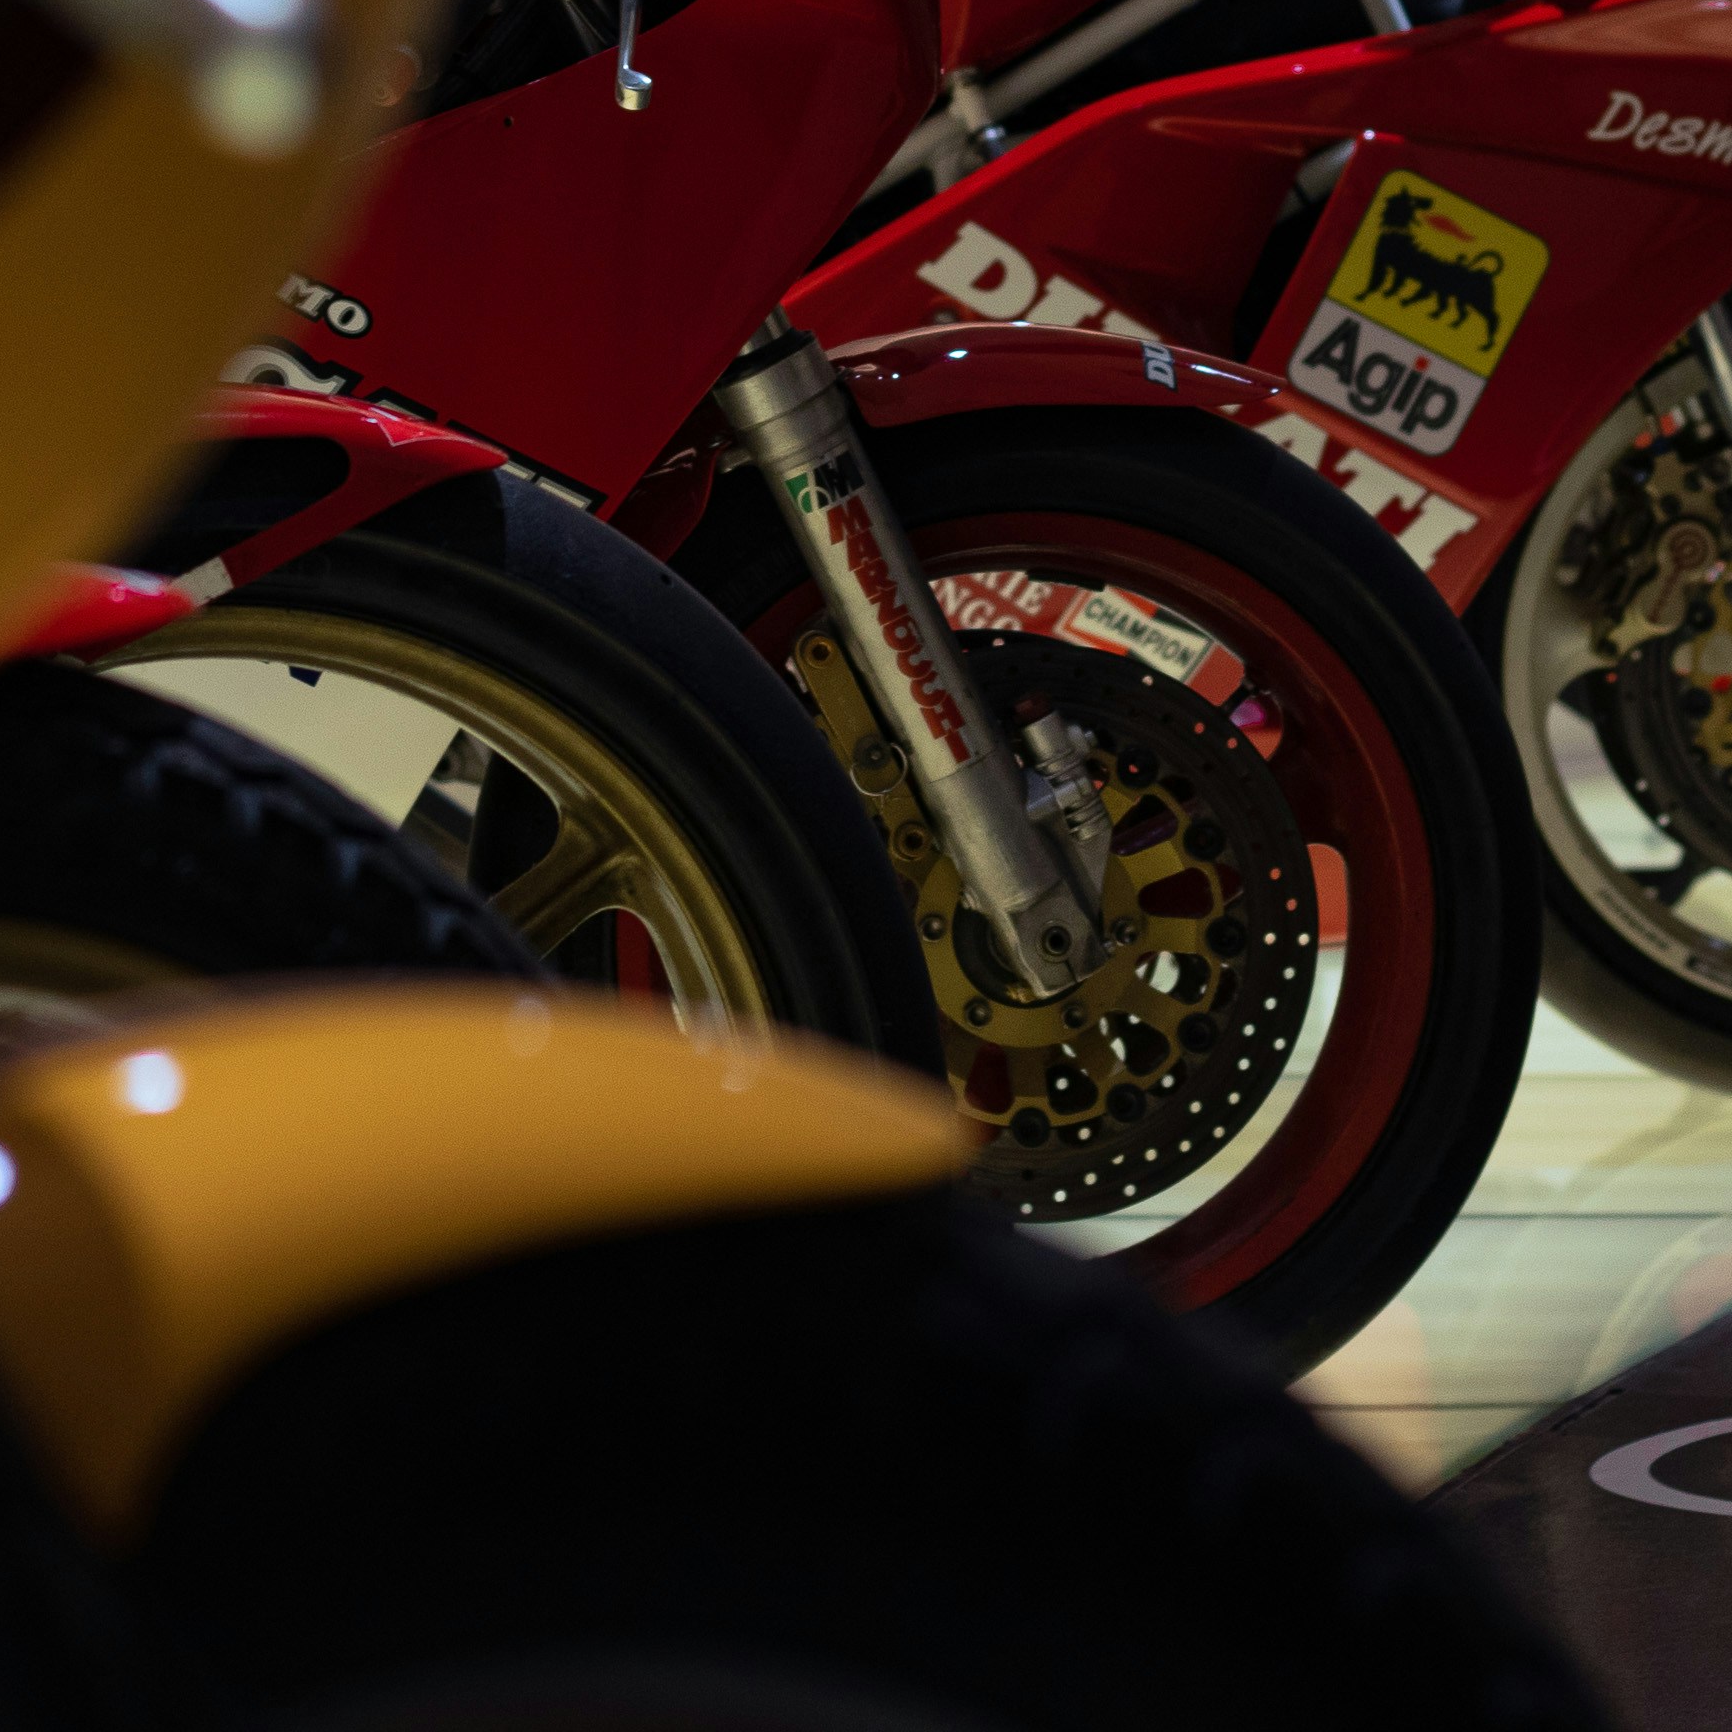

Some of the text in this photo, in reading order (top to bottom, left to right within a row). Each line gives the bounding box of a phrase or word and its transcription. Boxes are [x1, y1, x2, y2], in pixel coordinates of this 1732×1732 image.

[1304, 315, 1461, 437] Agip
[825, 494, 971, 767] MARZOCCHI
[1083, 595, 1197, 668] CHAMPION
